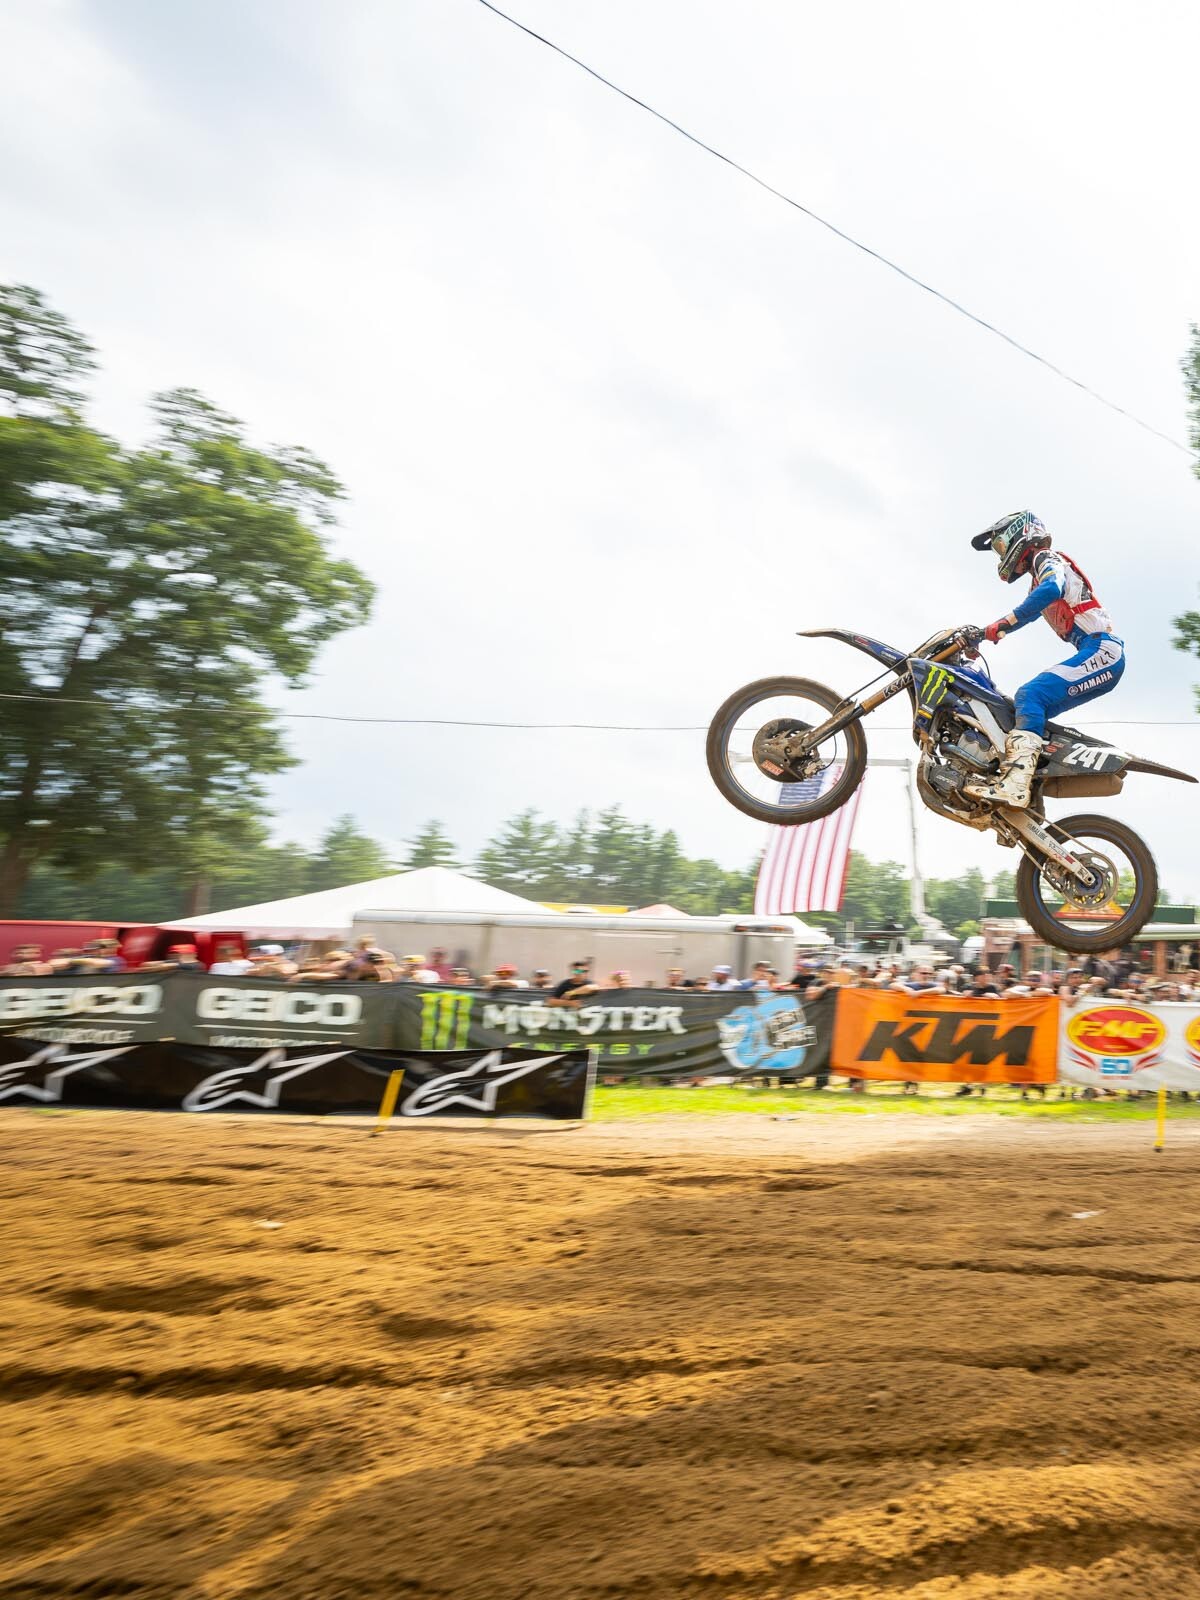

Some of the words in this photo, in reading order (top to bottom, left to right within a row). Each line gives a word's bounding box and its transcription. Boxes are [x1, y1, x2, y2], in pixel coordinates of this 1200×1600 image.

[1077, 670, 1113, 692] YAMAHA
[0, 984, 163, 1019] GEICO
[196, 987, 363, 1025] GEICO
[482, 1000, 688, 1036] MONSTER
[856, 1010, 1036, 1066] KTM
[1073, 1020, 1161, 1038] FMF
